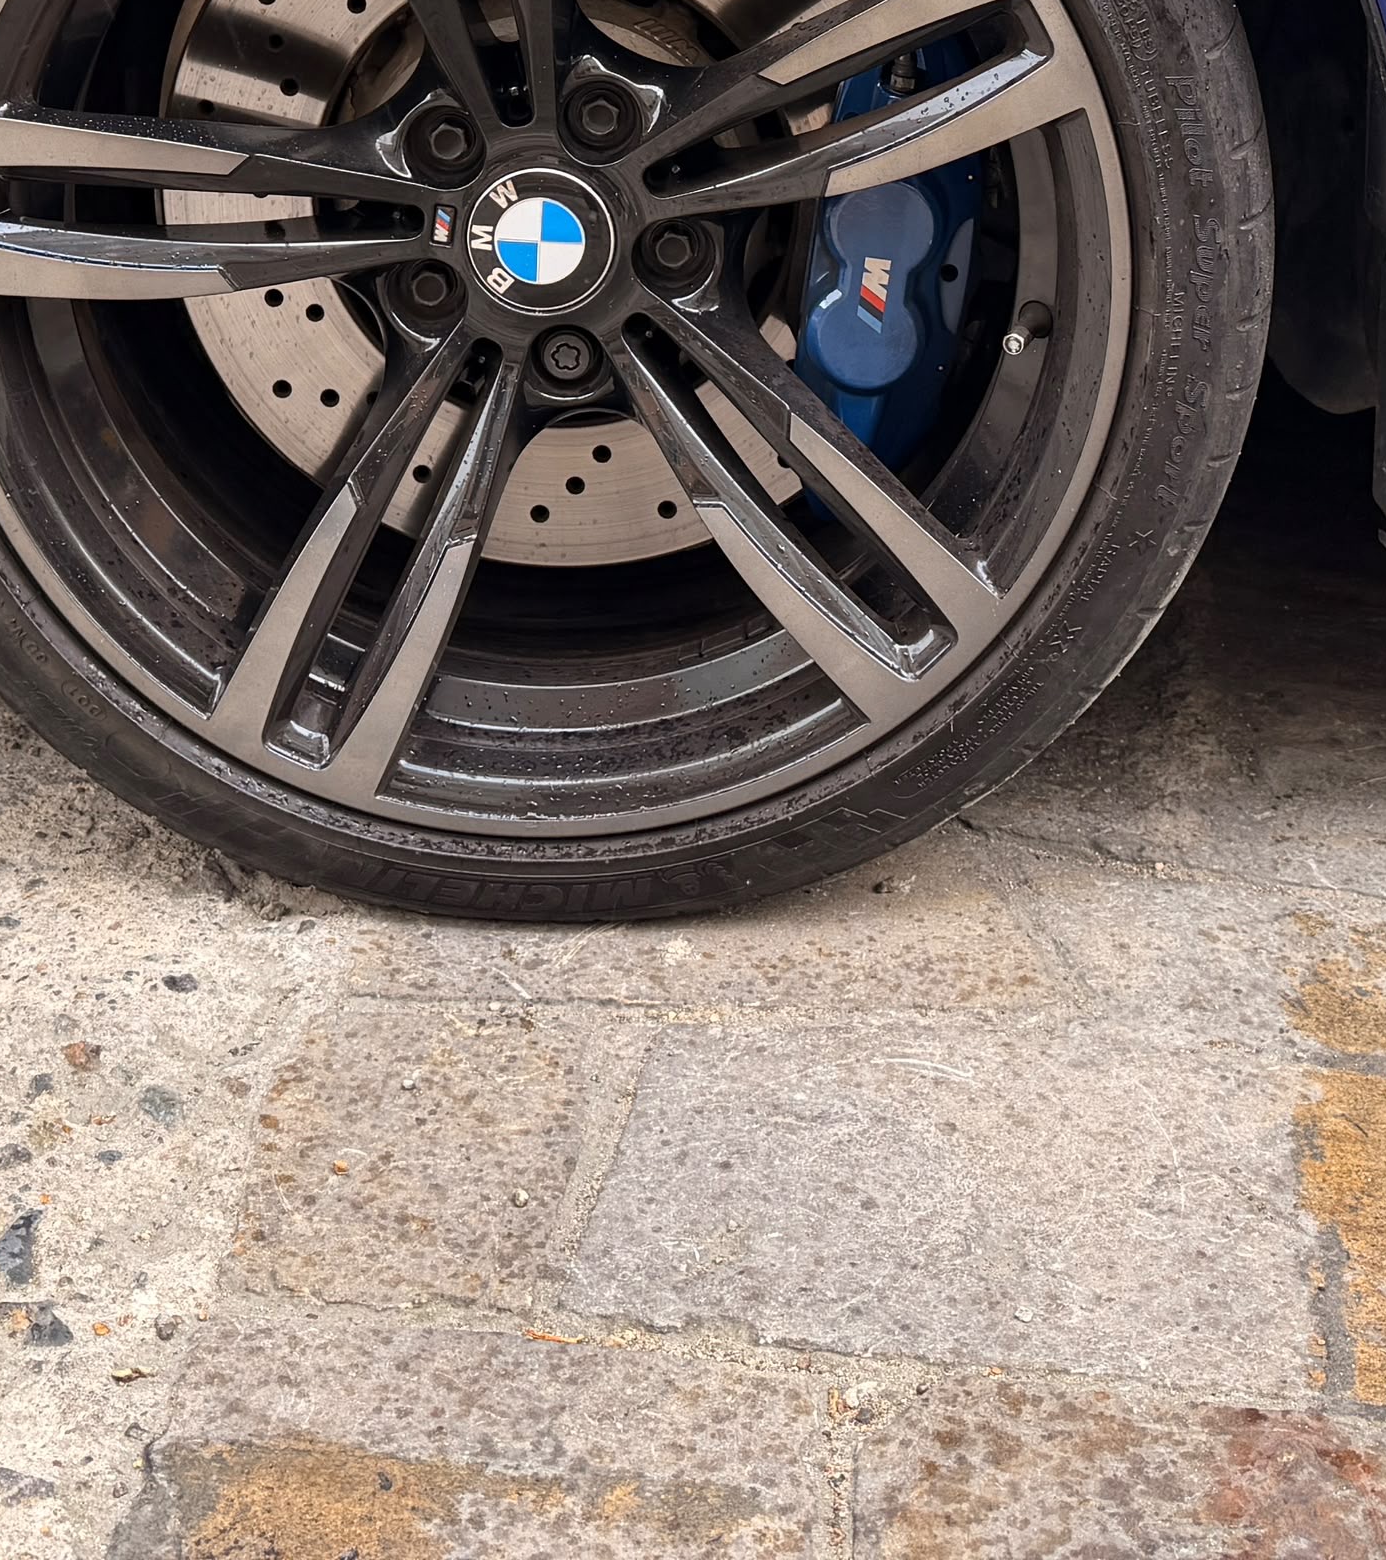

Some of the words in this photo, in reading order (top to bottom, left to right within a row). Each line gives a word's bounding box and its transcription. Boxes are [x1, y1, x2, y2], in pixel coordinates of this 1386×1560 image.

[1162, 67, 1216, 188] Pilot
[469, 179, 520, 295] BMW
[1185, 212, 1224, 353] Super
[1147, 371, 1214, 514] Sport
